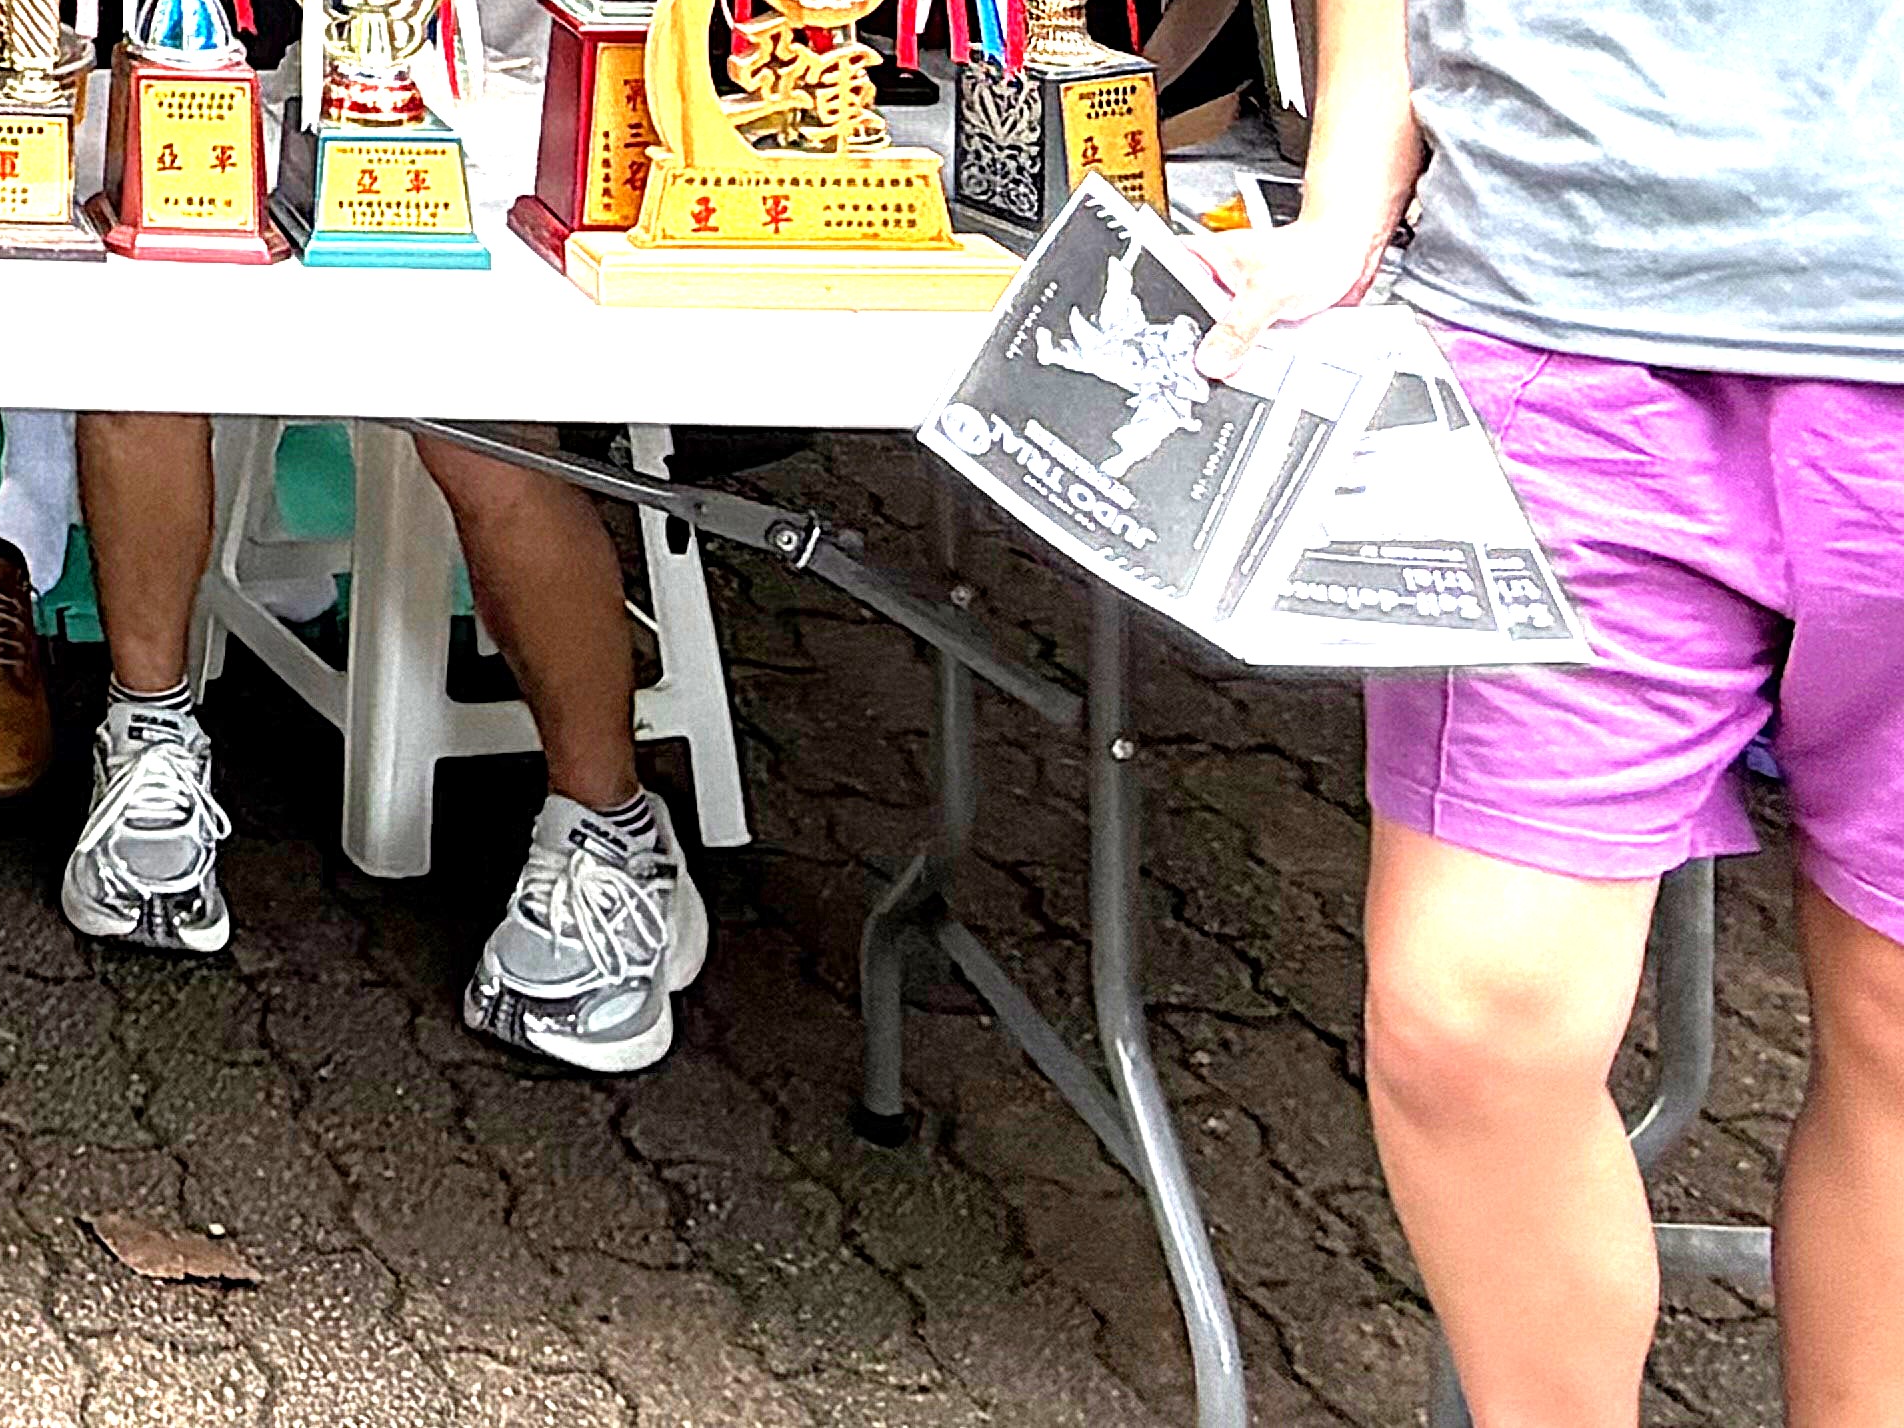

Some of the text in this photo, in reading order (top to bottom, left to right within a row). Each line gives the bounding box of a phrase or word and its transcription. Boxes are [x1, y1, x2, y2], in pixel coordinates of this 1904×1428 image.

[156, 142, 238, 174] 亞軍
[356, 169, 431, 194] 亞軍
[690, 194, 794, 235] 亞軍
[990, 412, 1064, 494] TRIAL
[1068, 482, 1158, 550] JUDO
